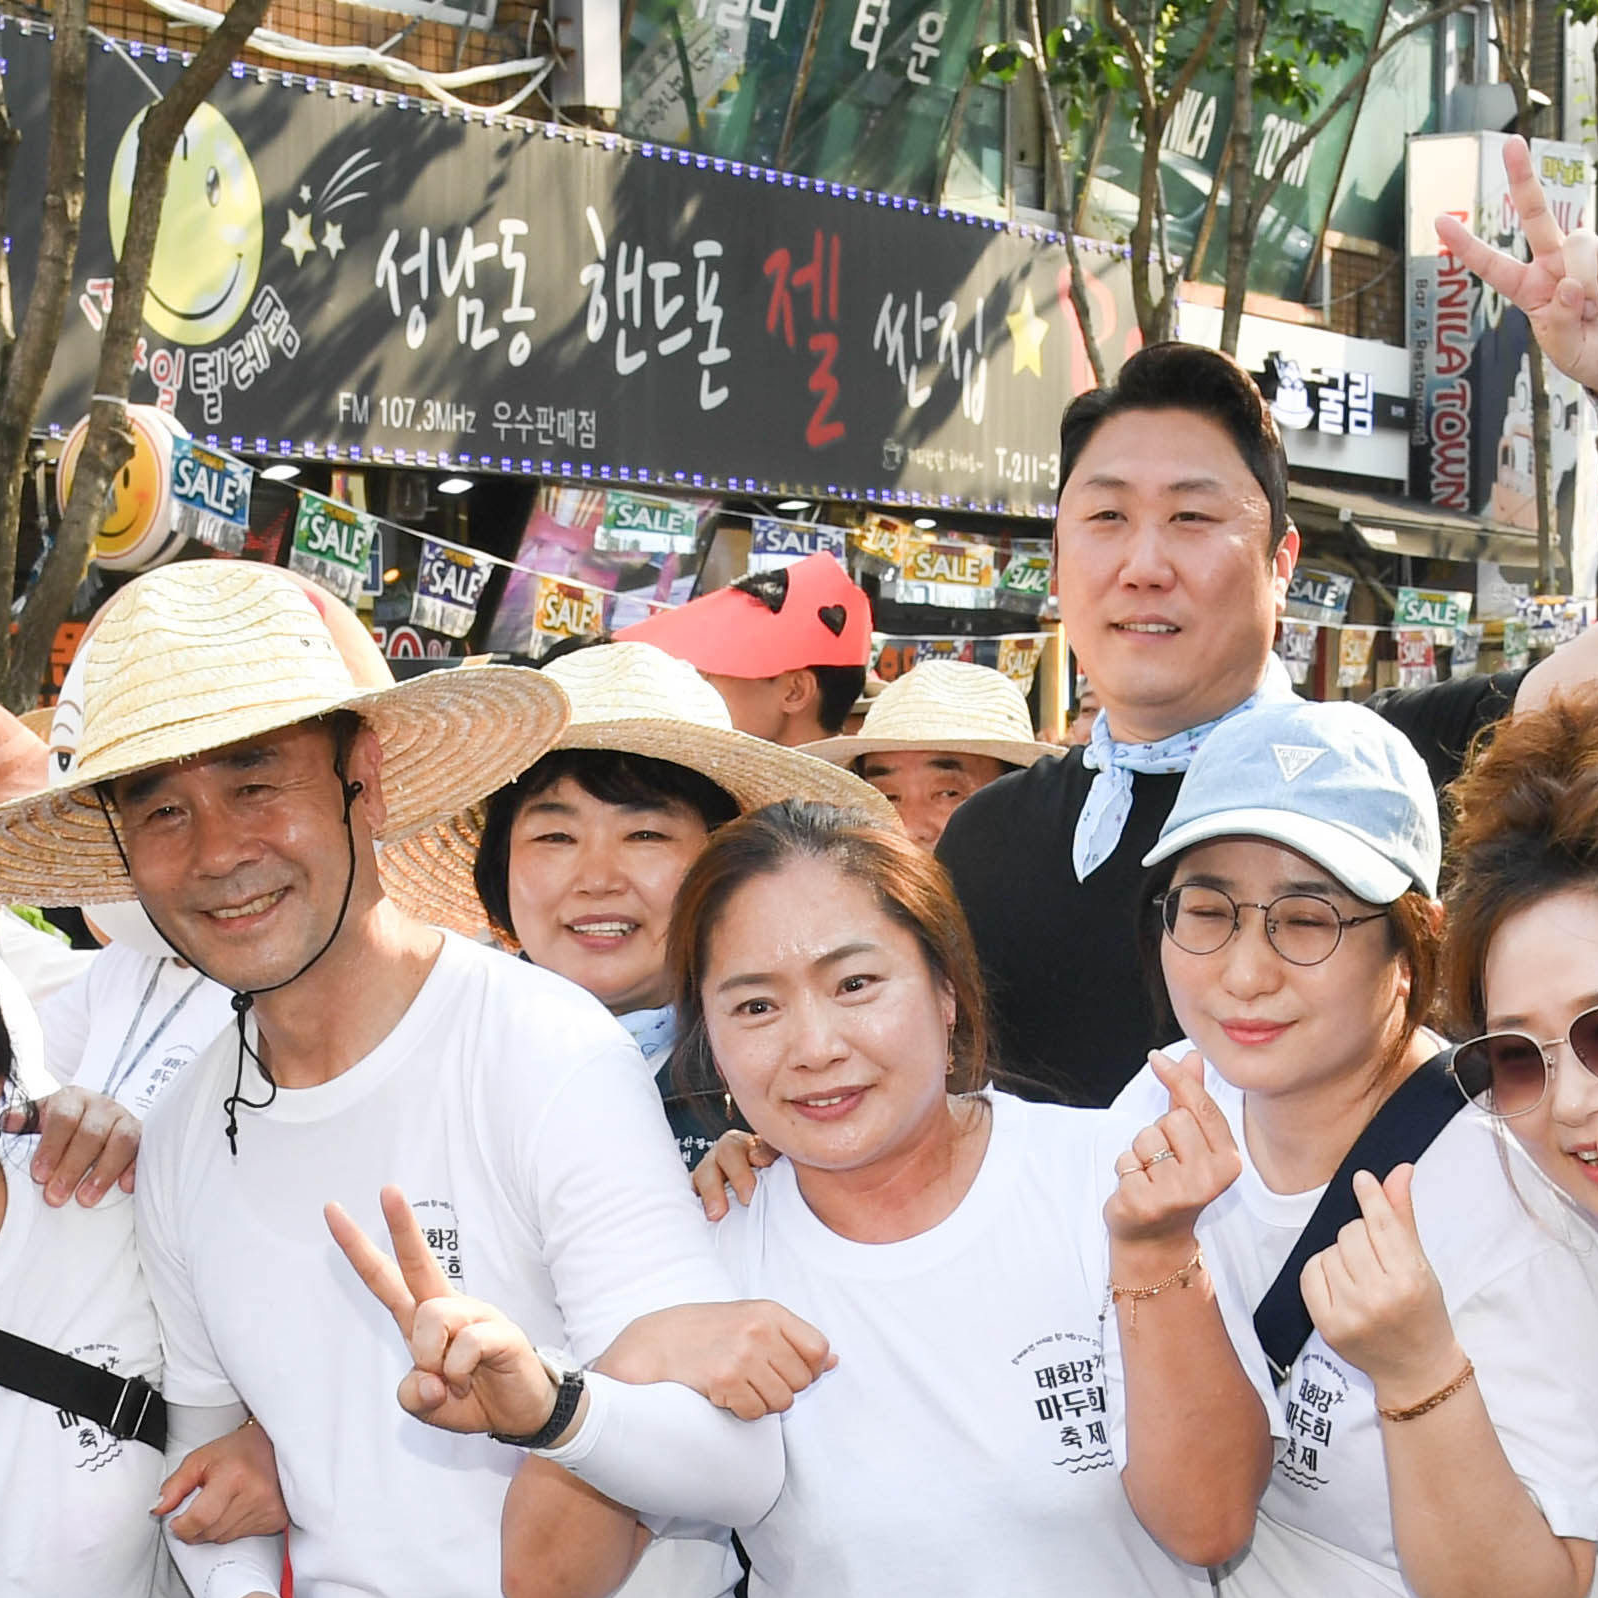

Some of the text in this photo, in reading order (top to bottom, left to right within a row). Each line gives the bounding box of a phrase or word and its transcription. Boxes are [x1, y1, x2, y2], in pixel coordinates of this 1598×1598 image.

[375, 218, 534, 368] 성남동
[580, 206, 731, 410] 핸드폰
[338, 391, 596, 449] FM 107.3MHz 우수판매점
[1432, 387, 1470, 511] TOWN
[174, 461, 236, 516] SALE
[617, 503, 683, 532] SALE
[308, 516, 365, 565] SALE
[430, 561, 481, 605] SALE
[914, 553, 981, 584] SALE
[544, 596, 592, 636] SALE
[1405, 601, 1460, 625] SALE
[422, 1229, 458, 1251] 화강
[1035, 1360, 1094, 1389] 태화강
[1035, 1386, 1106, 1421] 마두희
[1285, 1401, 1332, 1447] 마두희
